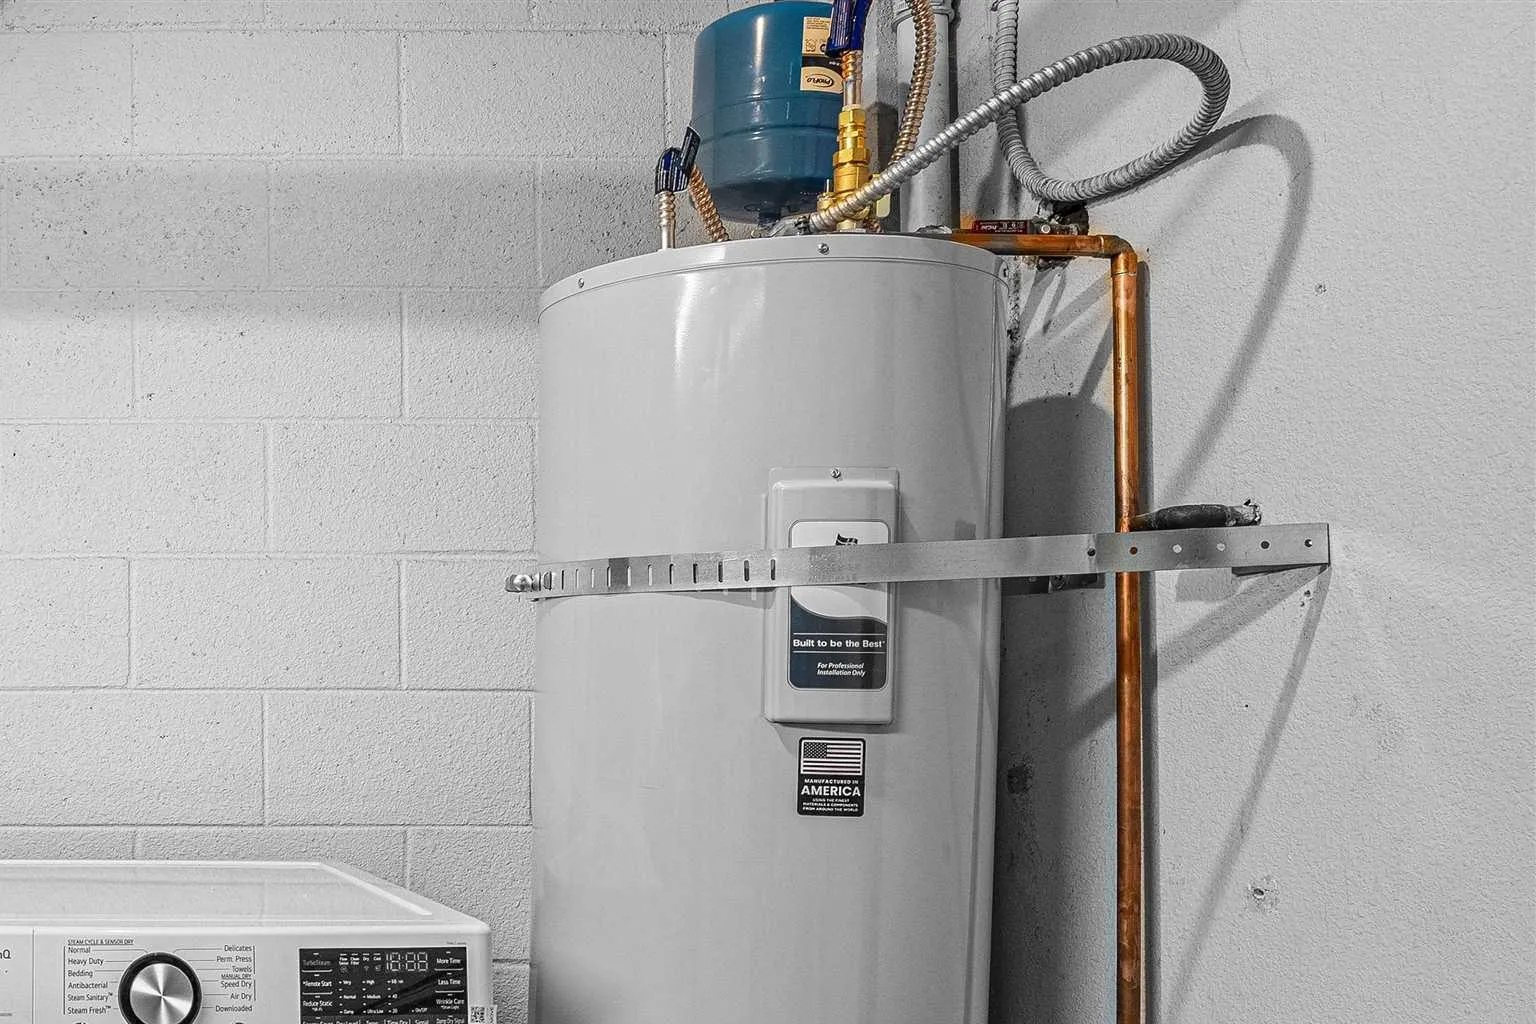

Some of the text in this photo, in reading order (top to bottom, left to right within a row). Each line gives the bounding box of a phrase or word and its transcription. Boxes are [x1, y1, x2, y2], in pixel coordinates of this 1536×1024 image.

[793, 639, 814, 647] Built
[801, 785, 861, 796] AMERICA
[68, 958, 104, 966] Heavy Duty
[68, 970, 93, 978] Bedding
[68, 981, 108, 989] Antibacterial
[221, 981, 252, 989] Speed Dry
[240, 993, 252, 1001] Dry
